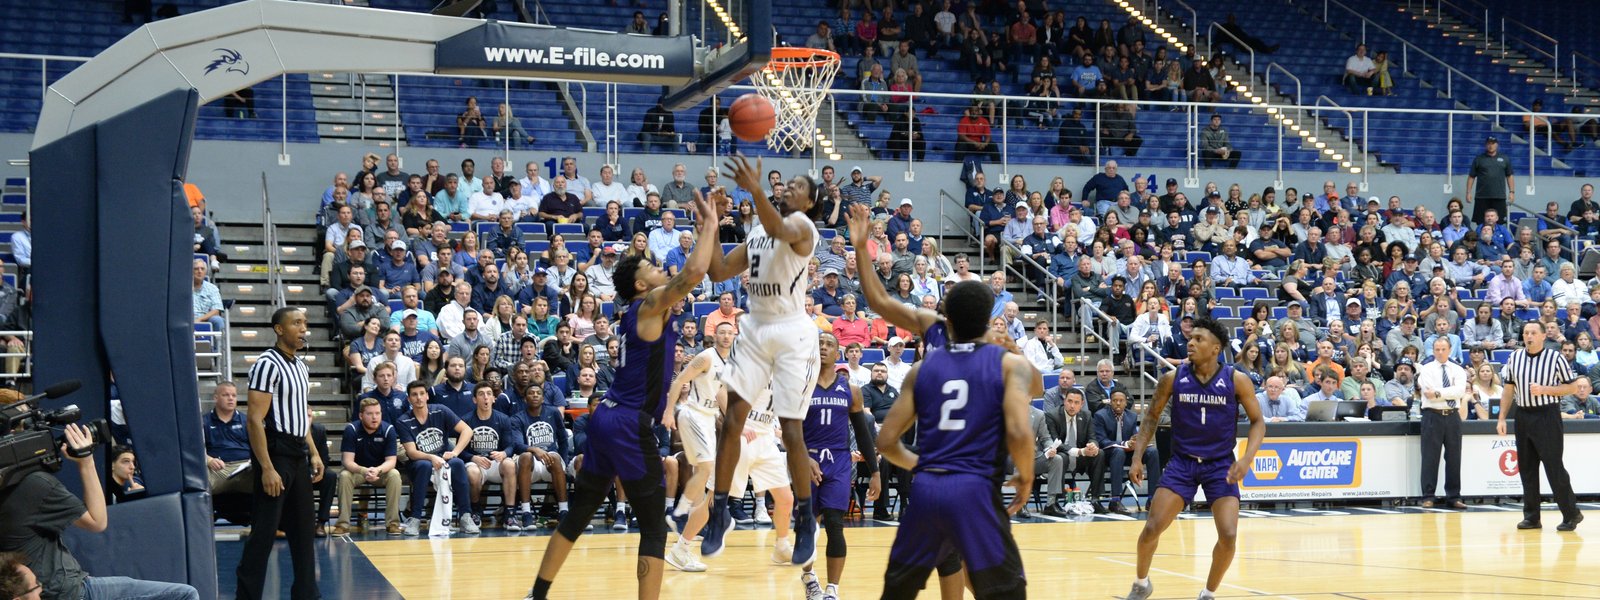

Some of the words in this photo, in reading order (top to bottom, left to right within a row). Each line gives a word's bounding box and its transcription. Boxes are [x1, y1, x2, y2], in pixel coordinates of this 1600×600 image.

[484, 46, 665, 69] www.E-file.com
[751, 254, 761, 278] 2
[810, 397, 822, 406] RTH
[822, 397, 849, 407] ALABAMA
[938, 379, 969, 430] 2
[1178, 393, 1199, 403] NORTH
[1199, 394, 1227, 405] ALABAMA
[820, 408, 832, 425] 11
[1200, 406, 1206, 425] 1
[474, 433, 494, 442] NORTH
[531, 427, 551, 438] NORTH
[470, 440, 498, 449] FLORIDA
[527, 432, 555, 448] FLORIDA
[1491, 440, 1517, 449] ZAXB
[1255, 458, 1278, 472] NAPA
[1286, 448, 1353, 466] AUTOCARE
[1299, 466, 1339, 479] CENTER
